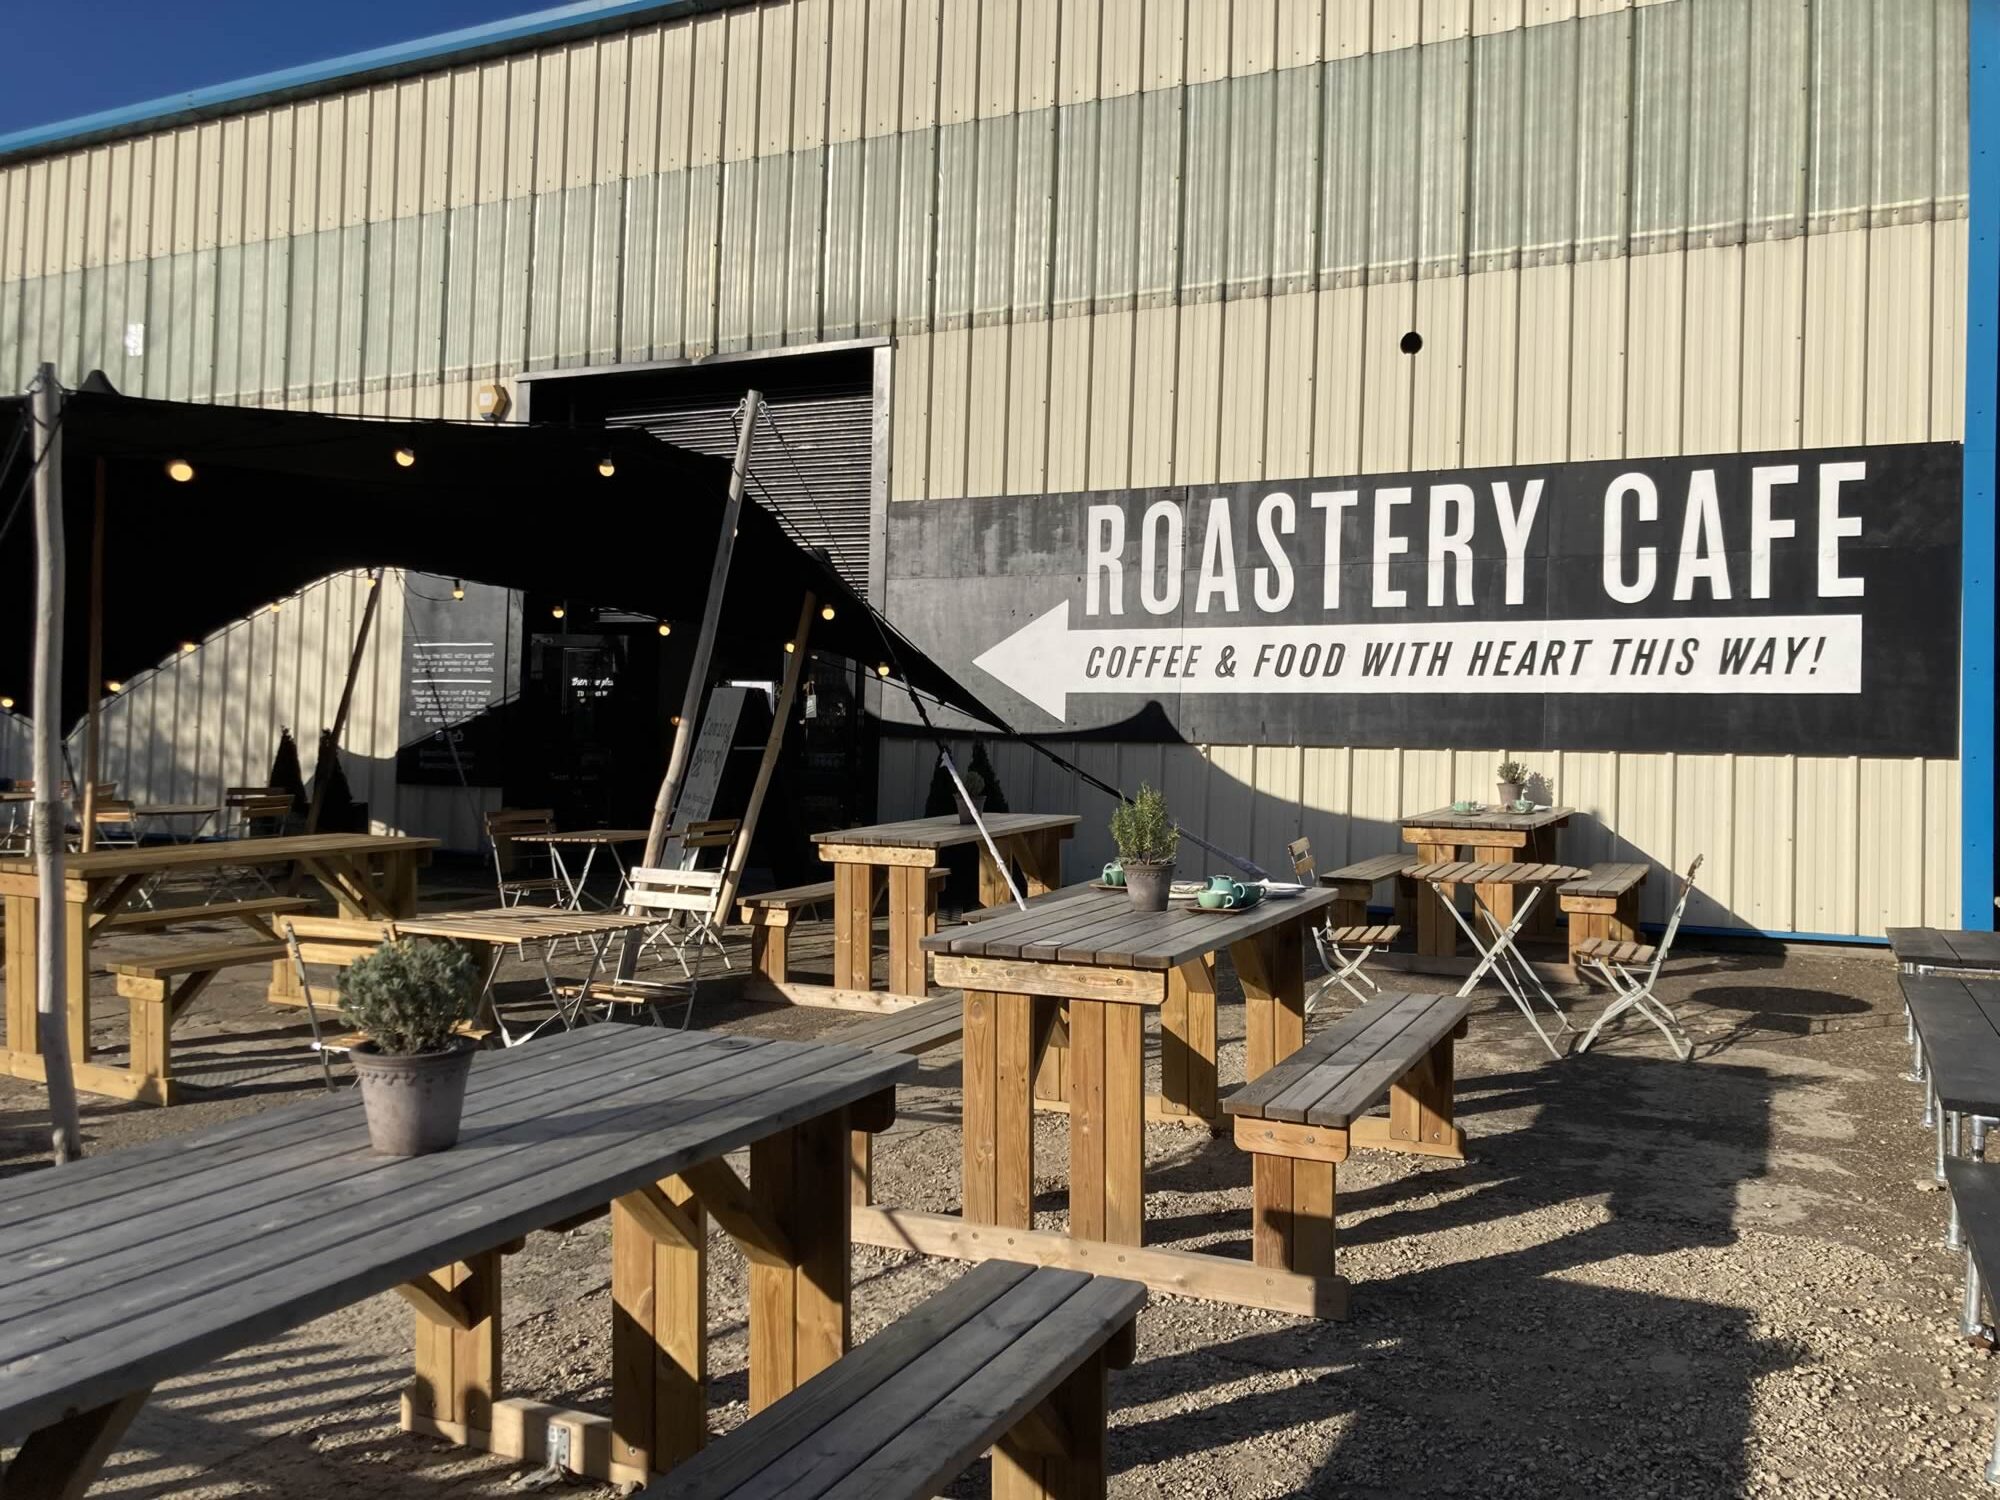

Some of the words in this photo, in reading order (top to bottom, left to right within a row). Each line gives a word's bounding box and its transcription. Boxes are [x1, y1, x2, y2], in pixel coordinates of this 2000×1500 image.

[1085, 478, 1545, 617] ROASTERY
[1602, 461, 1867, 604] CAFE
[1085, 645, 1203, 679] COFFEE
[1214, 645, 1238, 678] &
[1253, 643, 1347, 678] FOOD
[1361, 642, 1453, 677] WITH
[1466, 639, 1594, 677] HEART
[1609, 638, 1700, 676] THIS
[1718, 636, 1827, 676] WAY!
